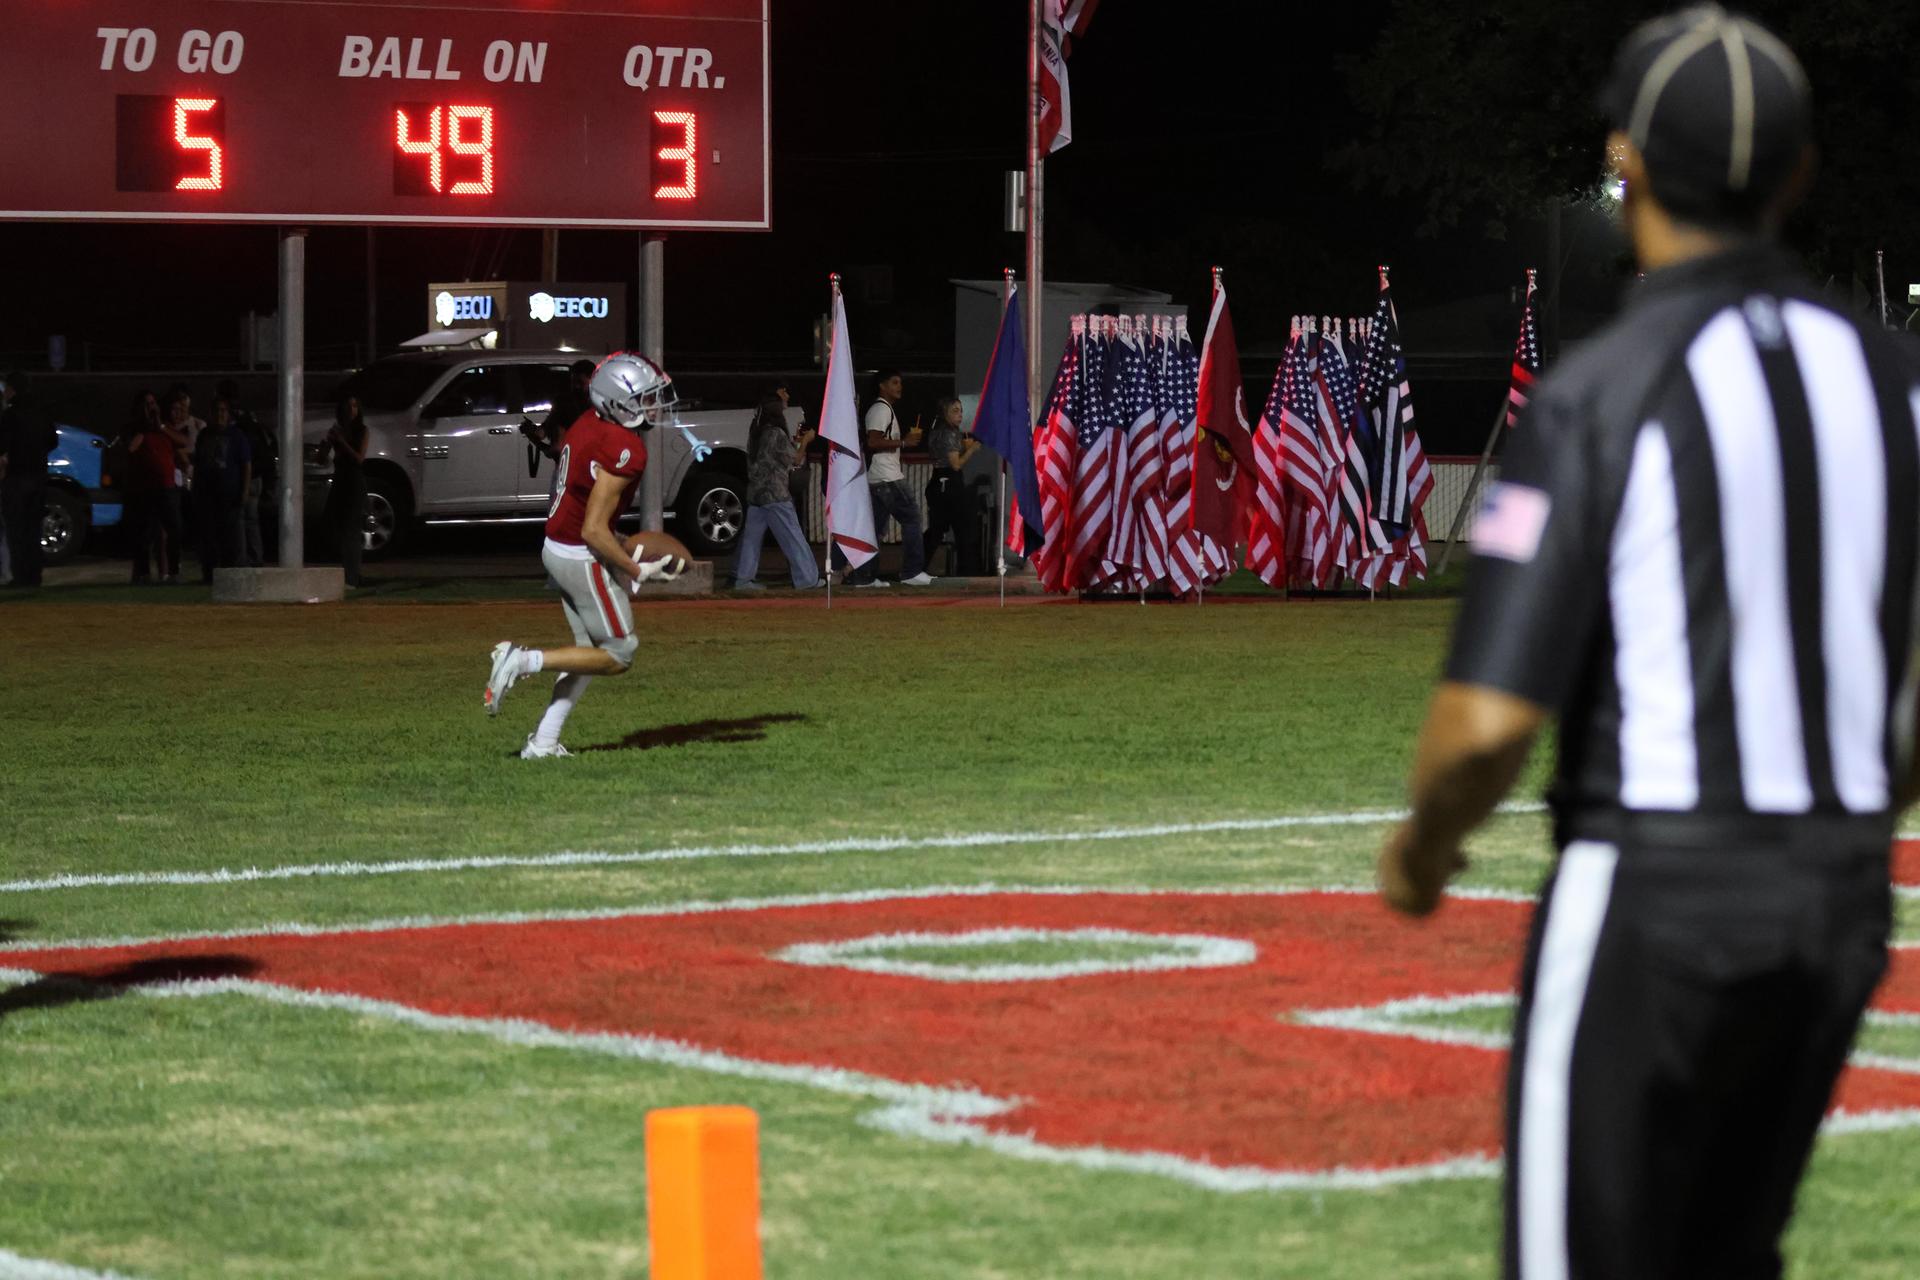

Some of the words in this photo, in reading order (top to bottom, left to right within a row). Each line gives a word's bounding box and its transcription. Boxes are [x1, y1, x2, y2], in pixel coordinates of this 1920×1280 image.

[98, 28, 157, 72] TO
[178, 30, 244, 75] GO
[339, 35, 460, 81] BALL
[484, 39, 548, 83] ON
[623, 45, 725, 91] QTR.
[173, 97, 223, 191] 5
[395, 104, 494, 196] 49
[653, 110, 697, 199] 3
[453, 296, 492, 320] EECU
[554, 296, 609, 319] EECU
[615, 448, 631, 469] 9
